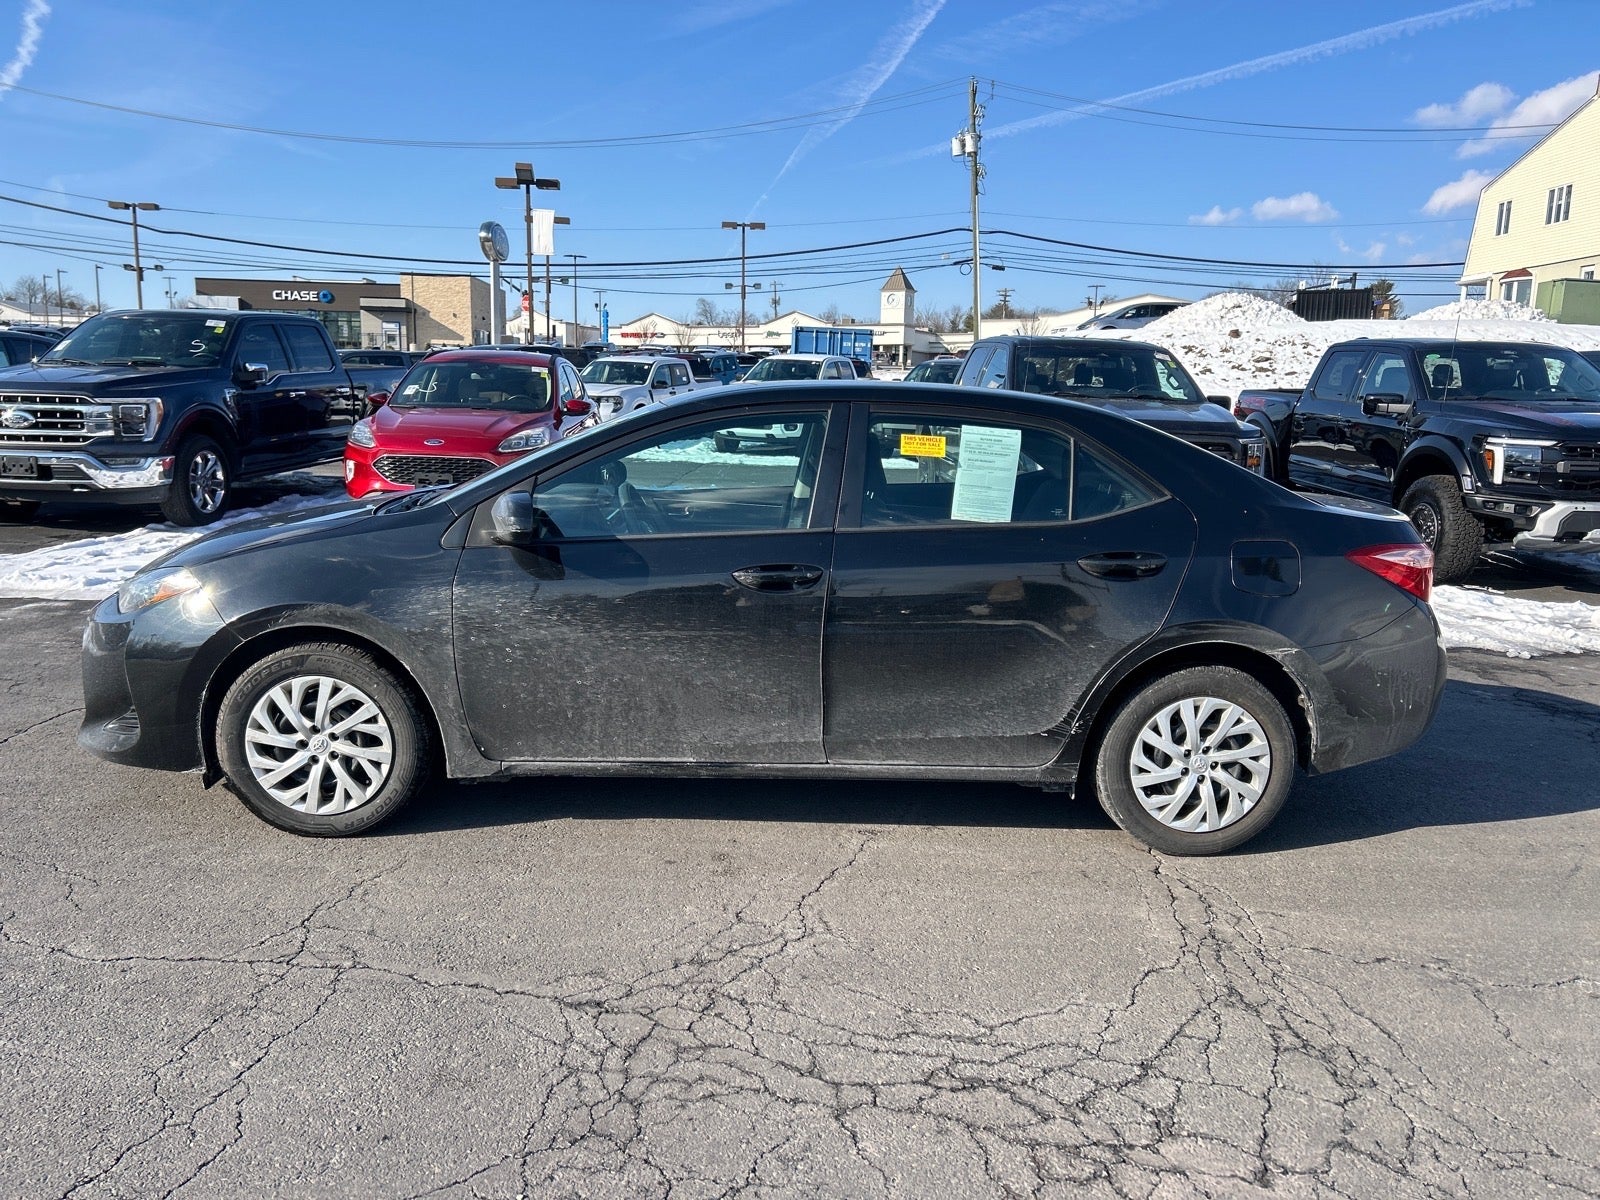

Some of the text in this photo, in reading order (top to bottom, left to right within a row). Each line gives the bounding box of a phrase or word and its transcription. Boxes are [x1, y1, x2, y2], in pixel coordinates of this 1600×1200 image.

[272, 289, 319, 301] CHASE
[236, 658, 294, 703] COOPER
[344, 788, 399, 830] COOPER
